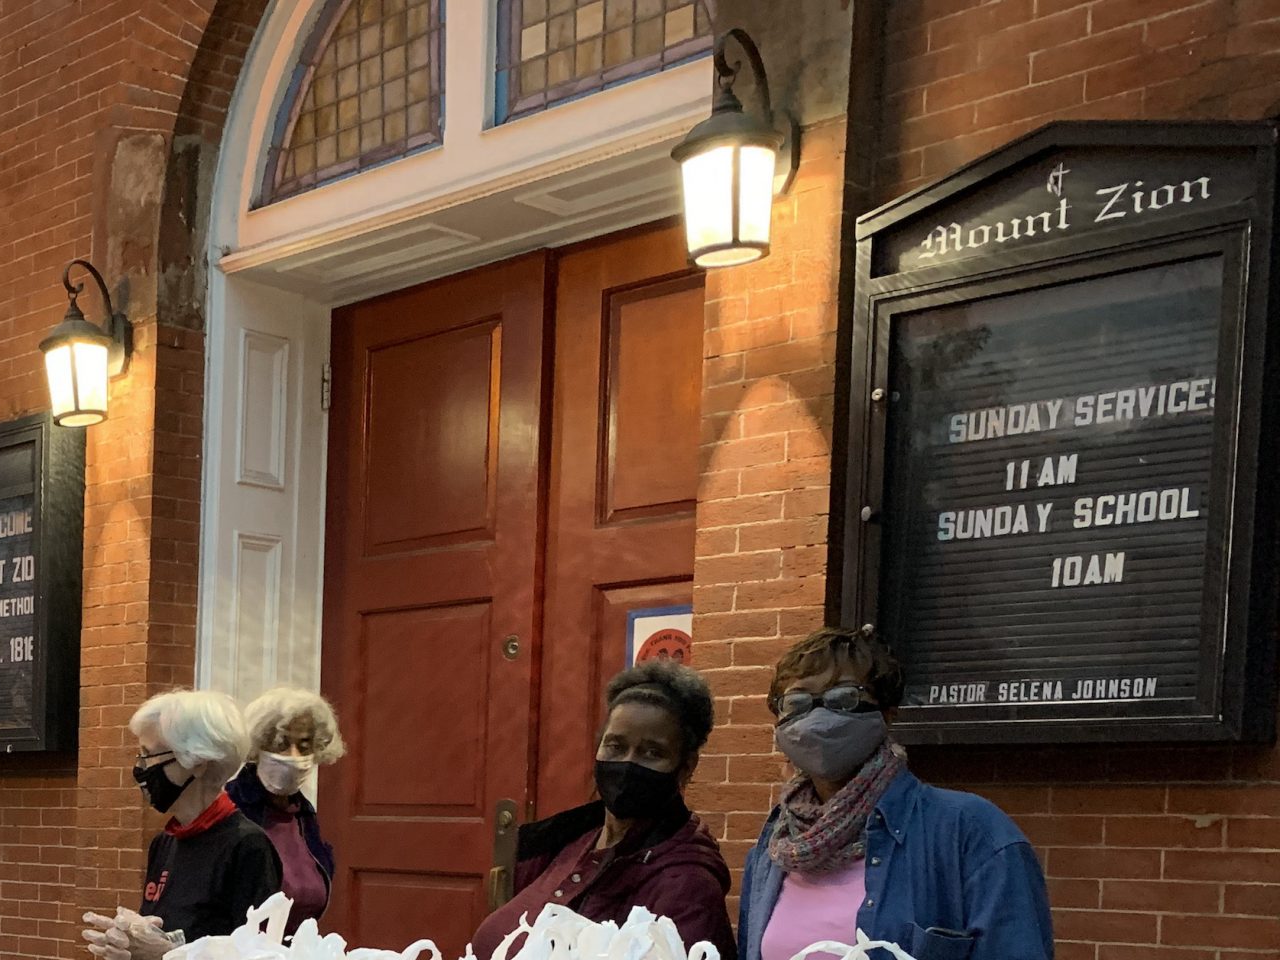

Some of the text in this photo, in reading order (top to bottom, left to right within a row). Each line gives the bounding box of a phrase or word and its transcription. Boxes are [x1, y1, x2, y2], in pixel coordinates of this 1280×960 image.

[919, 175, 1211, 259] Mount Zion
[949, 378, 1215, 443] SUNDAY SERVICE
[937, 488, 1200, 541] SUNDAY SCHOOL
[12, 555, 35, 583] ZIO
[1050, 552, 1125, 588] 10AM
[929, 677, 1157, 704] PASTOR SELENA JOHNSON
